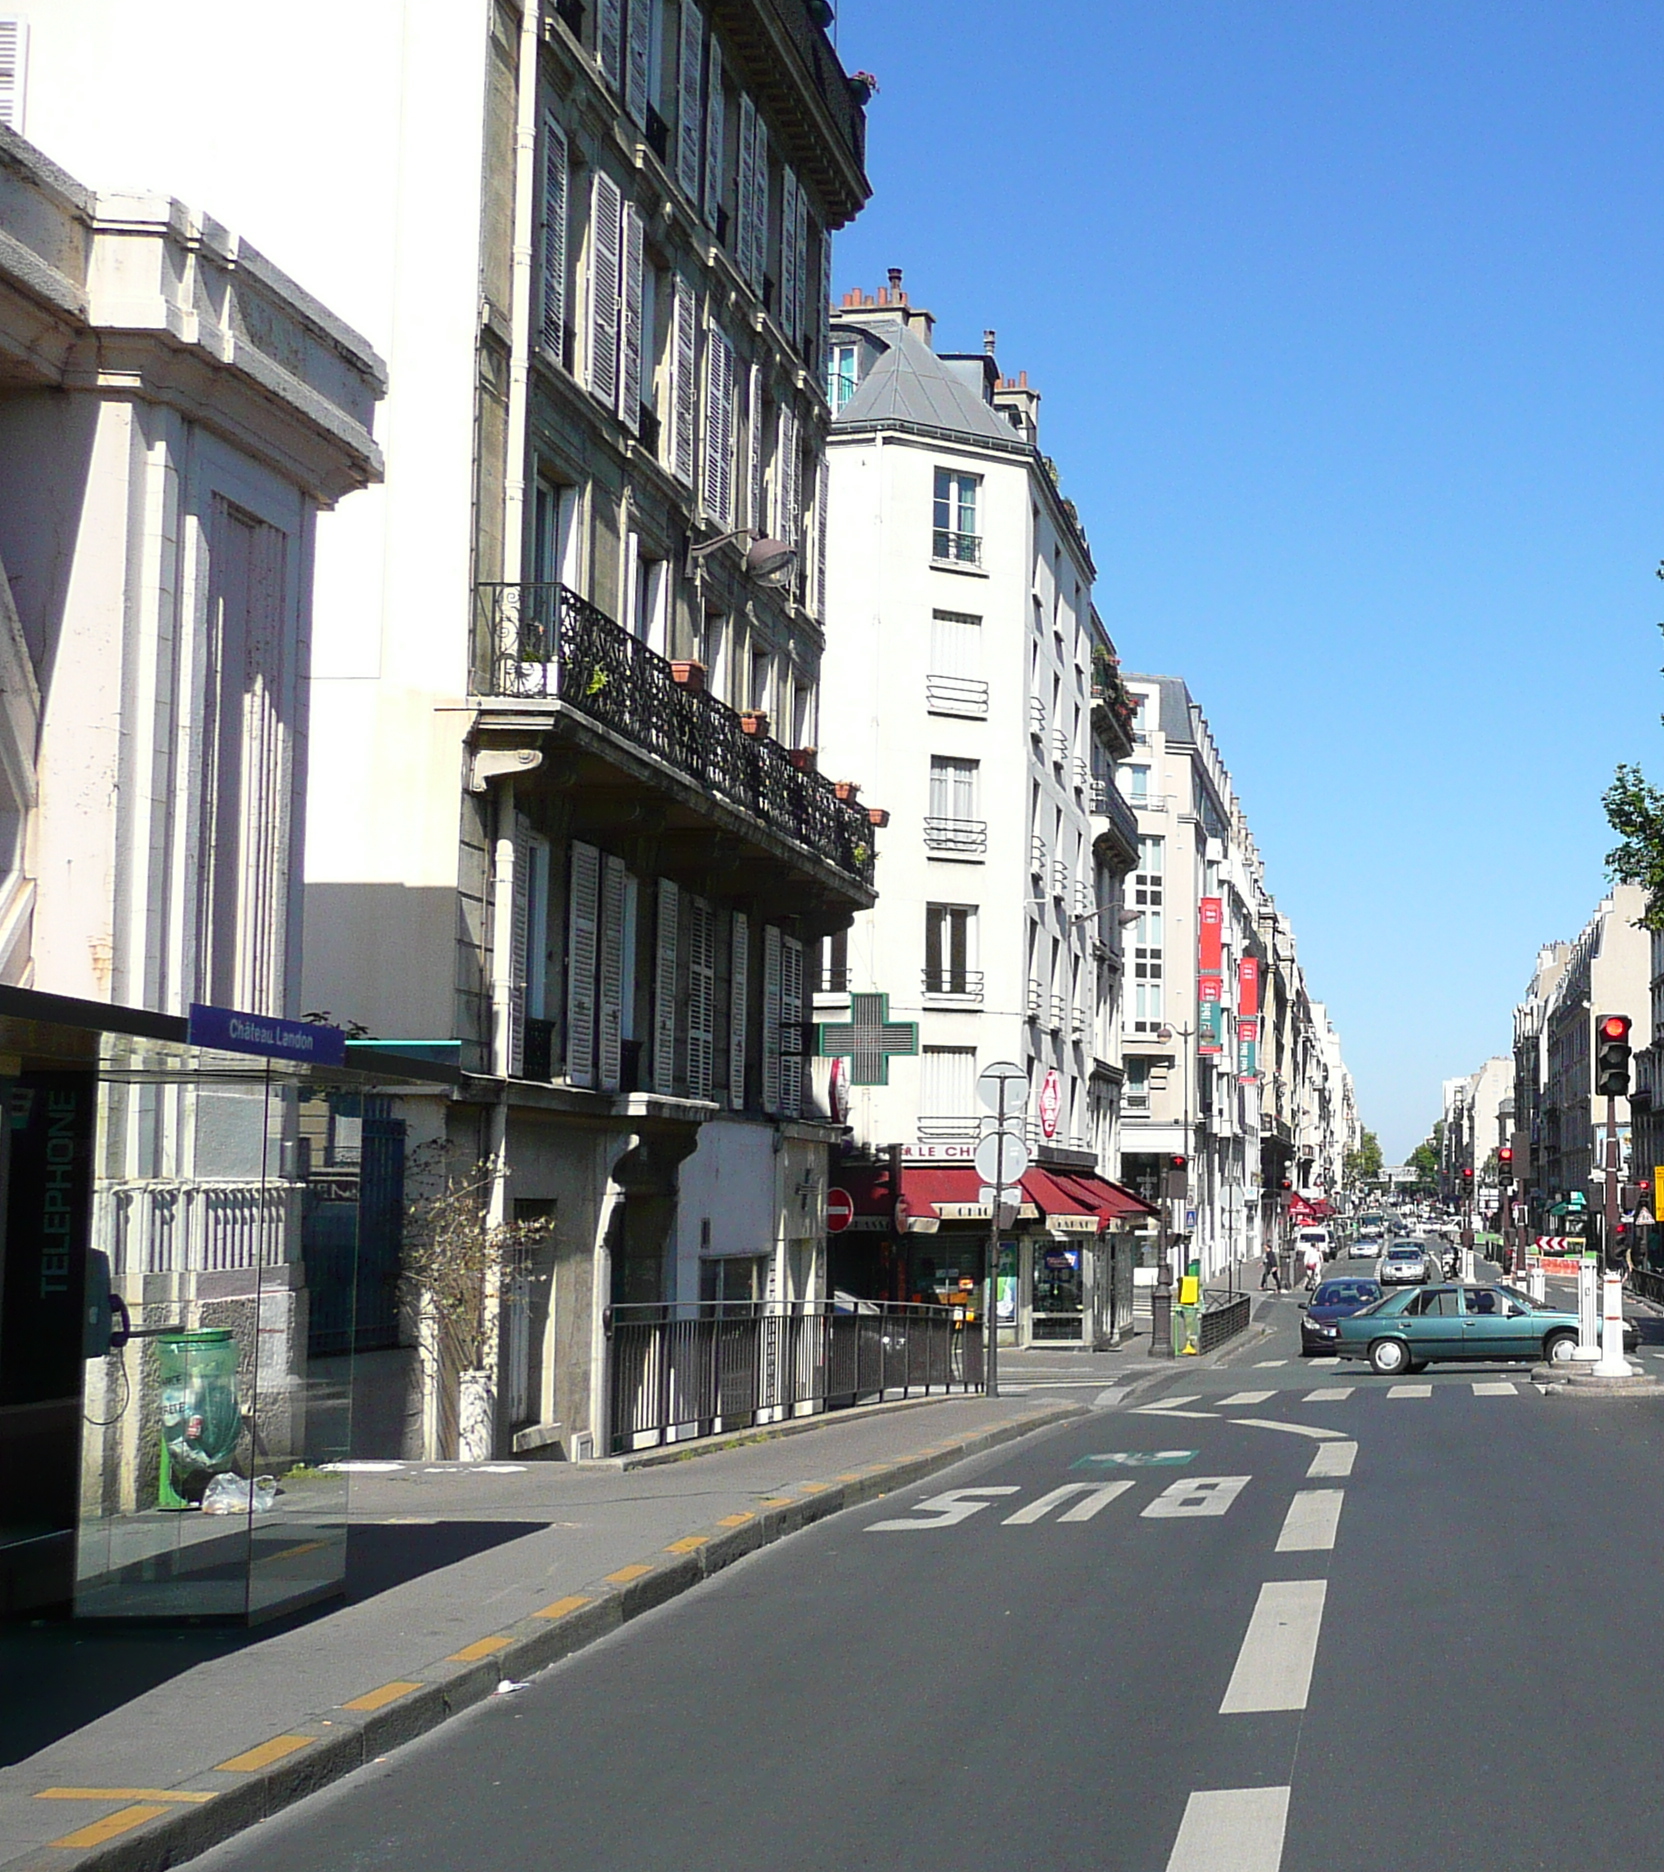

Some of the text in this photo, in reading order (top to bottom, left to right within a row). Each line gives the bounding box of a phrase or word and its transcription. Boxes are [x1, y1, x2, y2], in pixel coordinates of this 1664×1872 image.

[229, 1018, 314, 1050] Château Landon
[1042, 1070, 1057, 1132] TABAC
[918, 1146, 936, 1157] LE
[39, 1090, 76, 1299] TELEPHONE
[863, 1475, 1252, 1532] BUS
